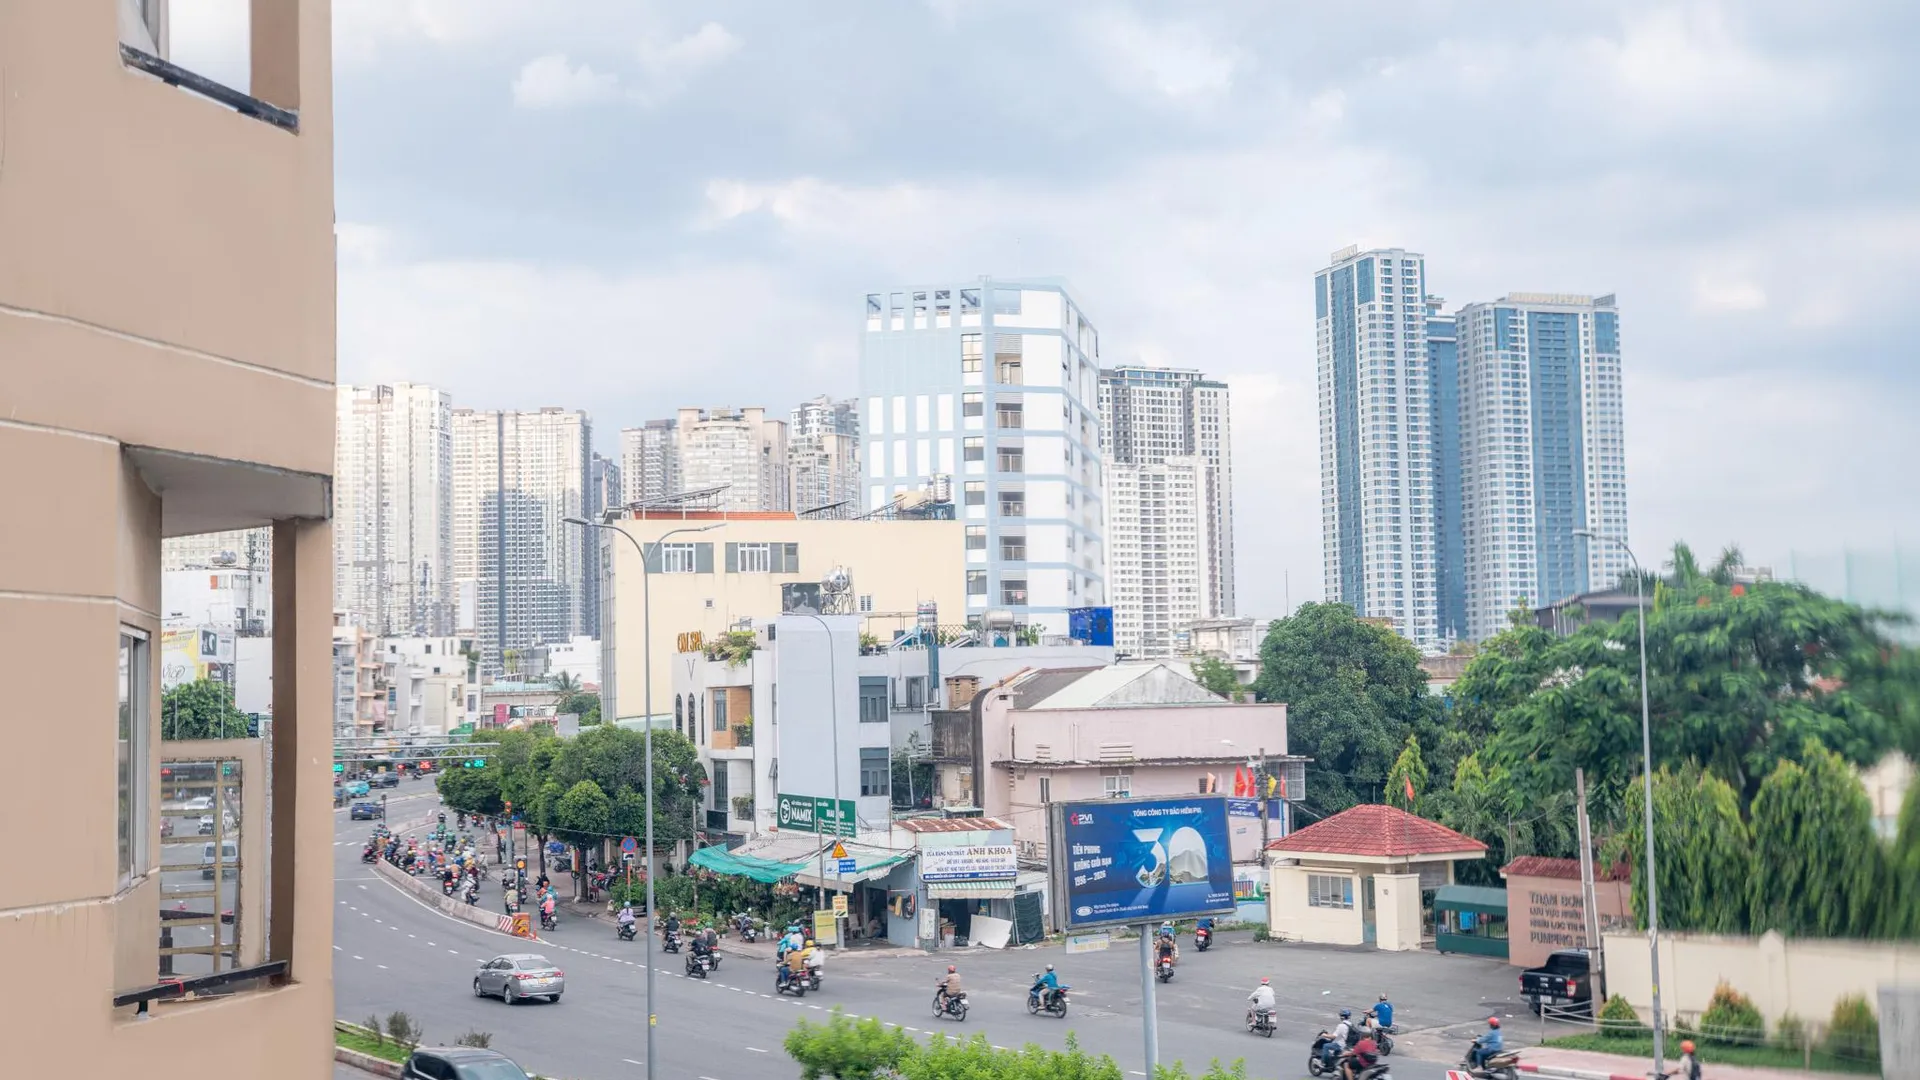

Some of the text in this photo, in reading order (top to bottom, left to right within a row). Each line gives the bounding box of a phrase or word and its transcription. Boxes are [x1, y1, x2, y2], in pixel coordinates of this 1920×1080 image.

[791, 807, 812, 822] NAMIX
[1078, 813, 1093, 821] PVI
[1148, 807, 1162, 817] CÔNG
[967, 847, 986, 856] ANH
[988, 847, 1012, 856] KHOA
[1132, 826, 1210, 889] 30
[1530, 931, 1573, 947] PUMPING
